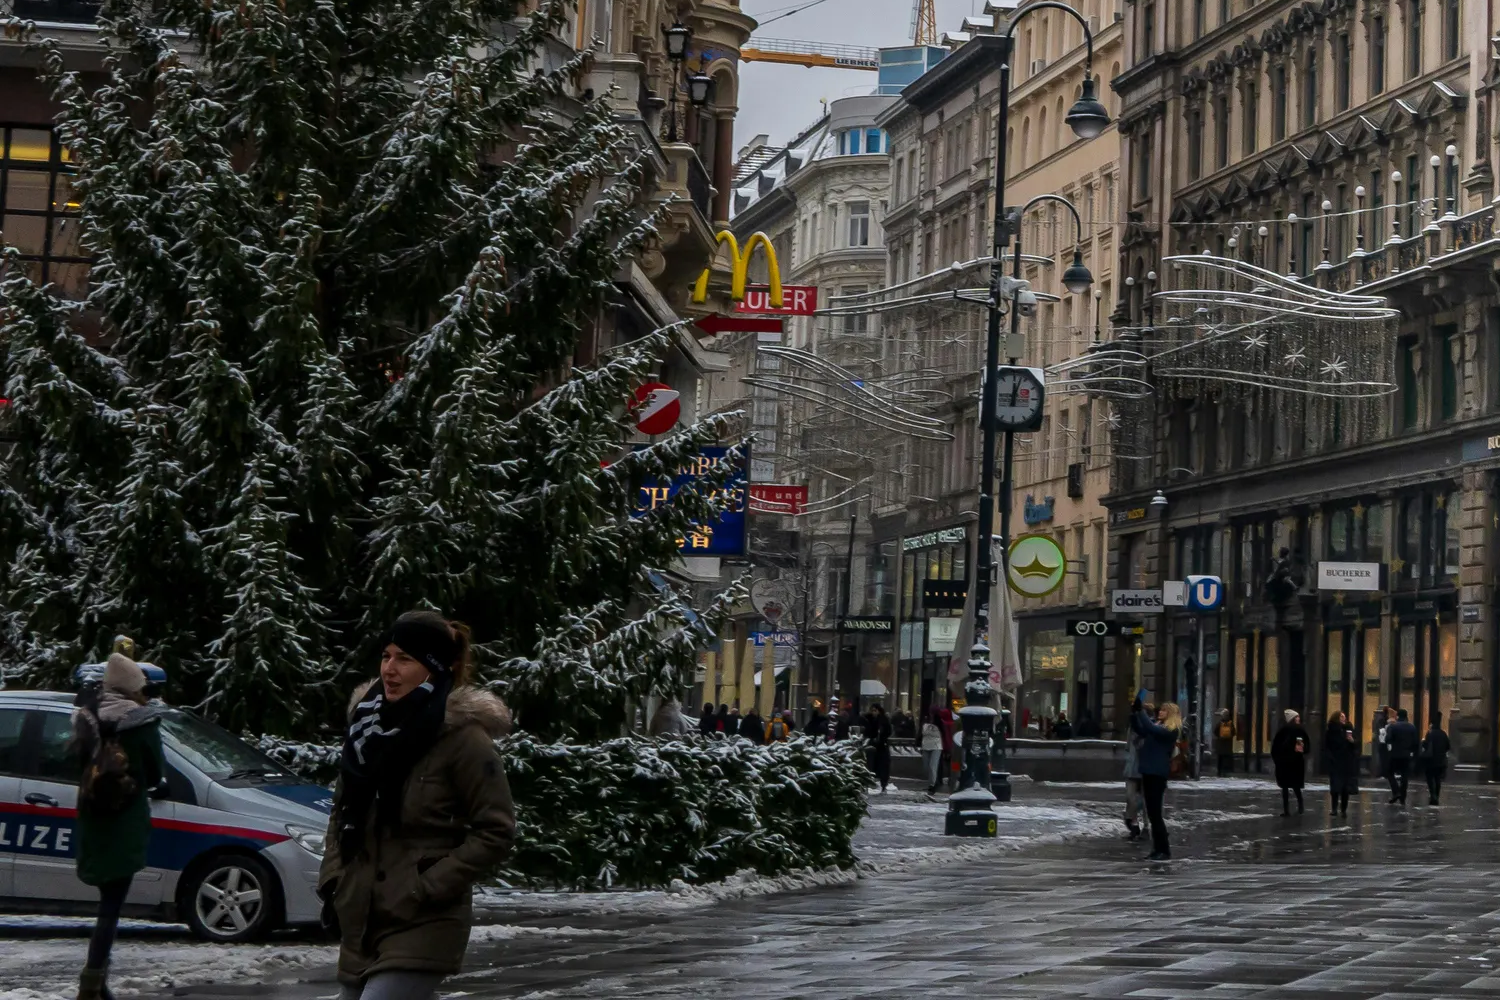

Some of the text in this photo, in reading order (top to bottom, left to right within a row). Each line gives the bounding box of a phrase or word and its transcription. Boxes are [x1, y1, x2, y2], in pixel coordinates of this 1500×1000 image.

[1326, 569, 1371, 577] BUCHERER
[1115, 593, 1161, 607] claire's
[1196, 583, 1218, 606] U
